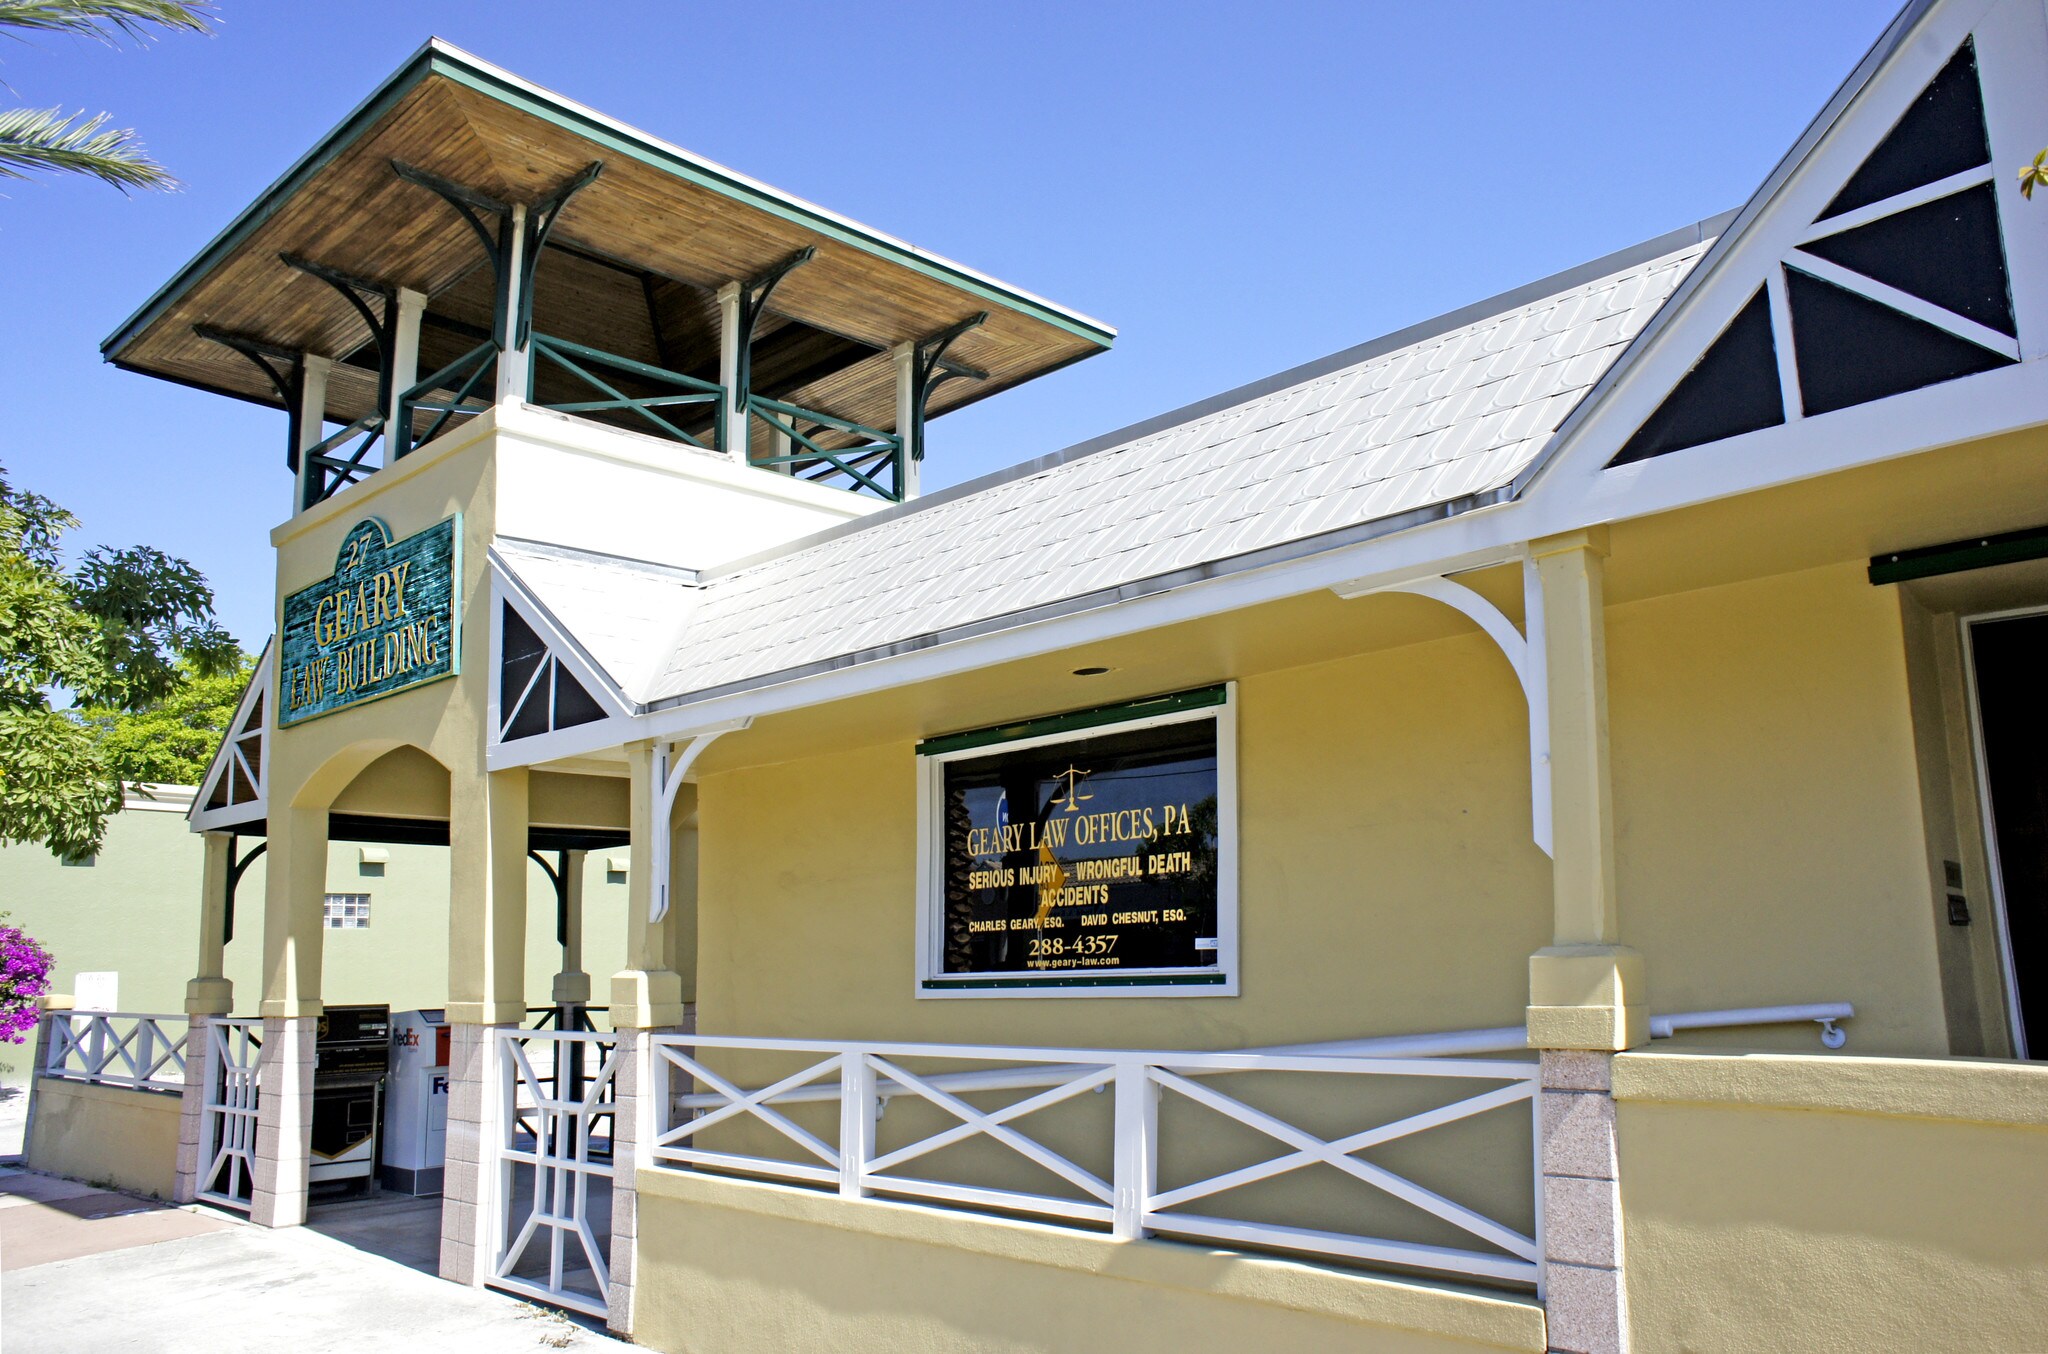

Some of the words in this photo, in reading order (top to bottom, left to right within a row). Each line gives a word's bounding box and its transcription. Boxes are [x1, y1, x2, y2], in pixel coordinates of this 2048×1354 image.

[346, 531, 373, 570] 27
[315, 561, 411, 647] GEARY
[290, 656, 330, 711] LAW
[336, 615, 438, 695] BUILDING
[967, 823, 1025, 857] GEARY
[1029, 818, 1069, 850] LAW
[1074, 807, 1158, 845] OFFICES,
[1163, 803, 1192, 836] PA
[969, 868, 1014, 890] SERIOUS
[1019, 865, 1058, 885] INJURY
[1076, 856, 1142, 881] WRONGFUL
[1148, 851, 1191, 874] DEATH
[1040, 884, 1109, 908] ACCIDENTS
[968, 919, 1007, 933] CHARLES
[1044, 917, 1065, 929] ESQ.
[1081, 914, 1107, 926] DAVID
[1112, 911, 1159, 925] CHESNUT,
[1163, 908, 1187, 922] ESQ.
[1028, 934, 1119, 957] 288-4357
[1027, 955, 1120, 969] www.geary-law.com
[393, 1027, 419, 1046] FedEx
